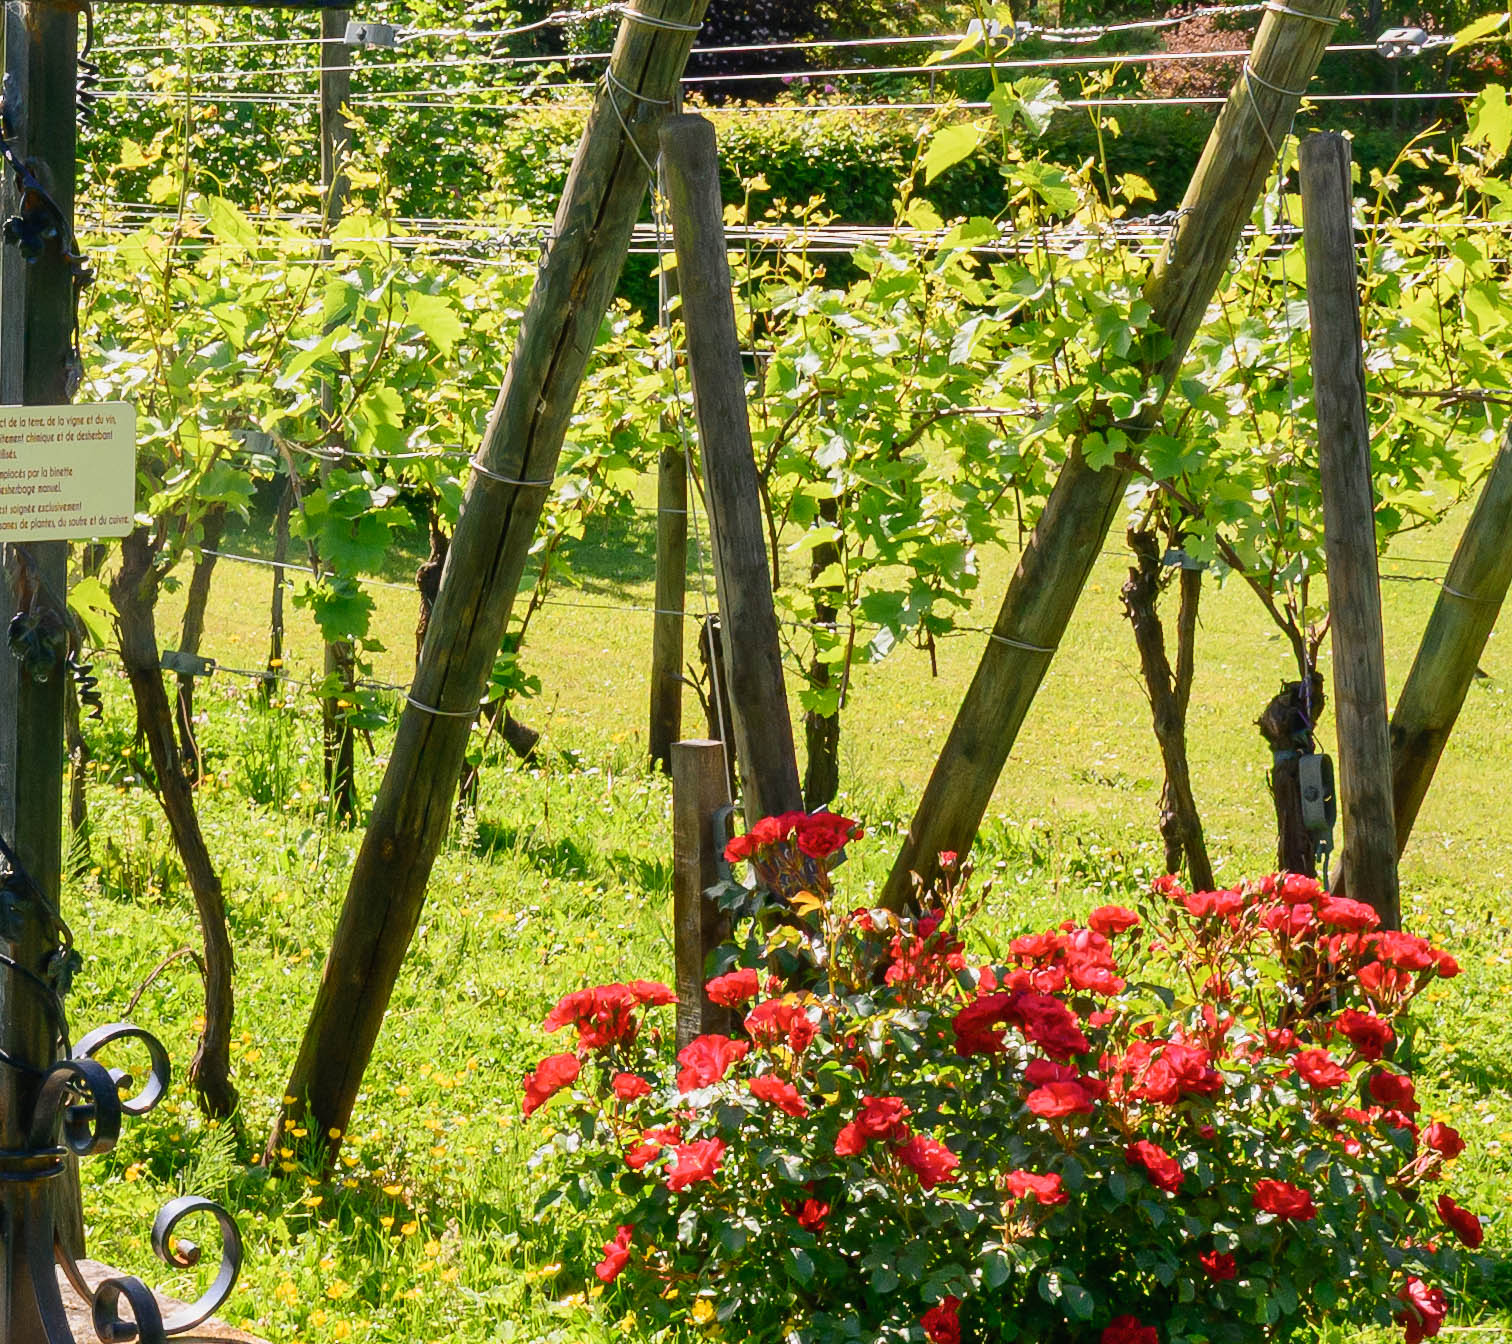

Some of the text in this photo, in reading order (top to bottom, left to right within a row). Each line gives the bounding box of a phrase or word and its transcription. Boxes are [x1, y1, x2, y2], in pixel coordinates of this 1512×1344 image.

[8, 416, 18, 428] de
[20, 416, 26, 428] la
[47, 416, 56, 426] de
[58, 416, 65, 426] la
[66, 416, 84, 427] vigne
[86, 415, 93, 425] et
[95, 414, 104, 425] du
[56, 431, 64, 442] et
[65, 430, 74, 442] de
[27, 470, 39, 480] par
[41, 467, 48, 478] la
[49, 467, 73, 478] binette
[10, 504, 36, 516] soignée
[38, 501, 82, 513] exclusivement
[19, 518, 28, 530] de
[57, 517, 67, 528] du
[68, 516, 88, 527] soufre
[89, 516, 97, 526] et
[98, 514, 107, 526] du
